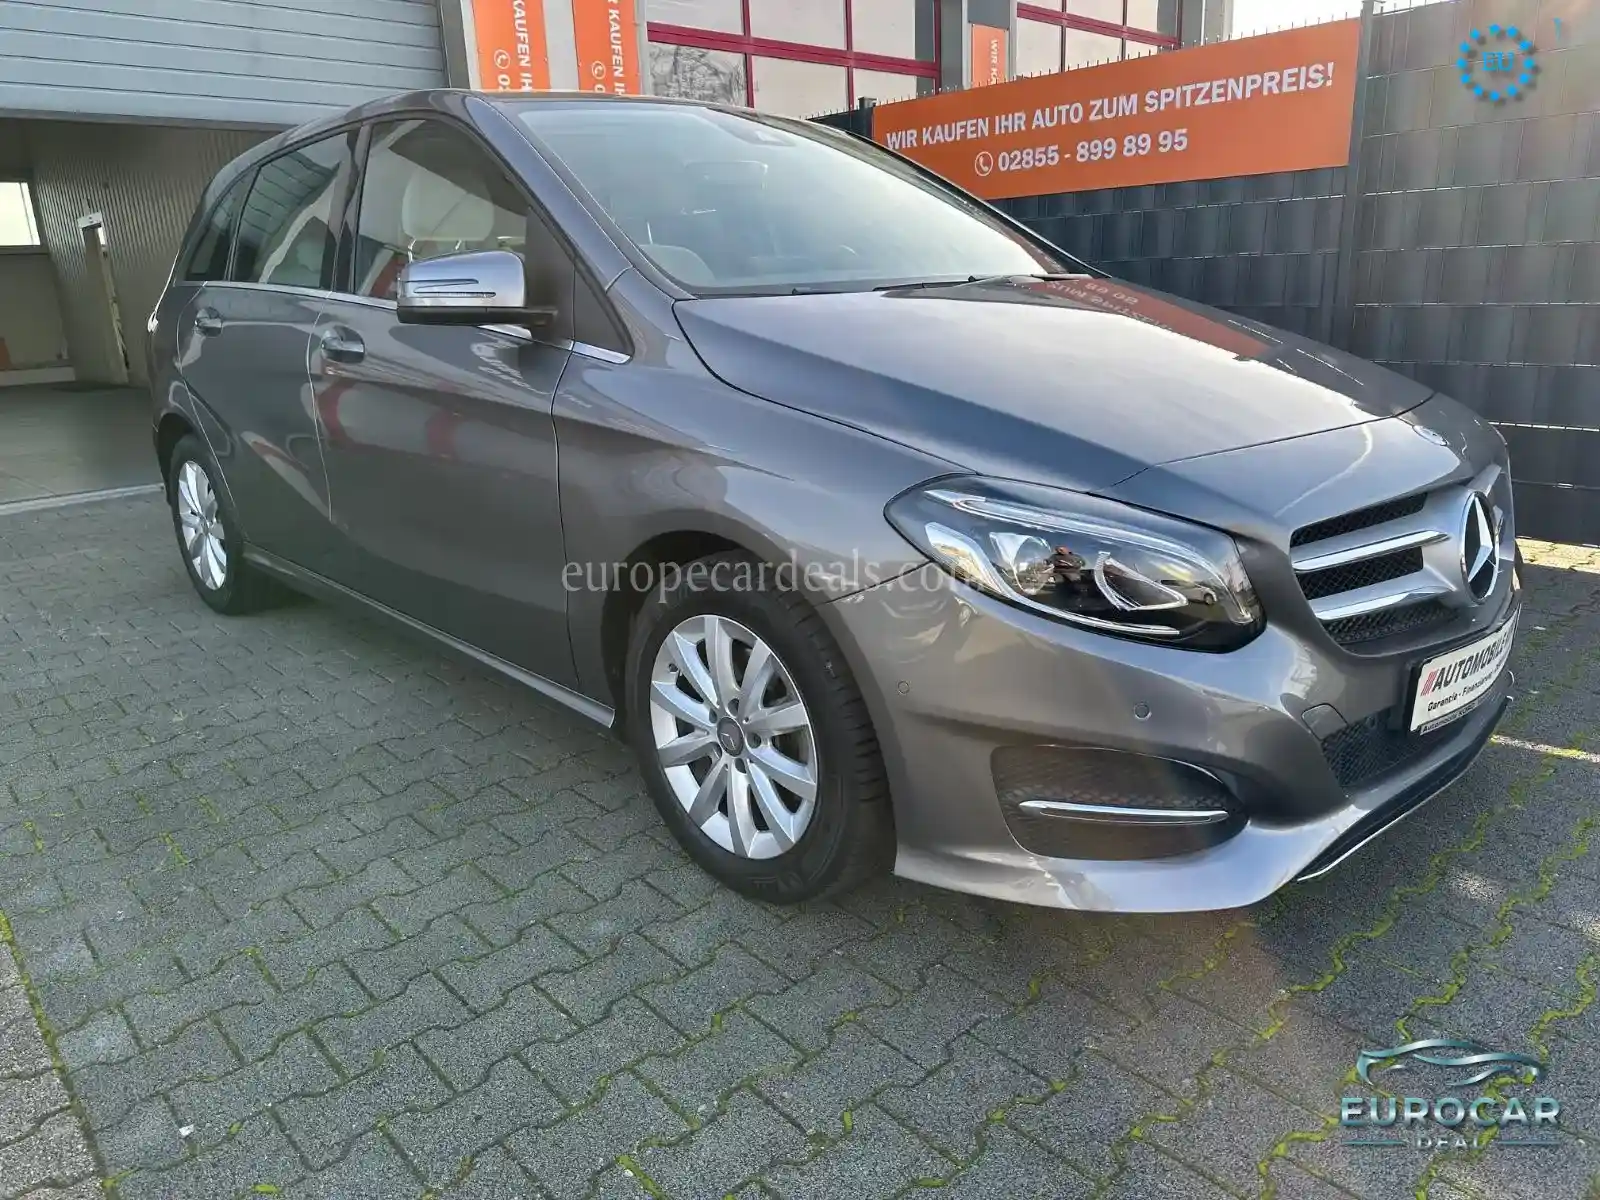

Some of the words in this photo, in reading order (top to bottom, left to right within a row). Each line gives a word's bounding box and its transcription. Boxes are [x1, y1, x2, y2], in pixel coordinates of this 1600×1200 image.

[609, 9, 625, 78] KAUFEN
[886, 129, 918, 150] WIR
[922, 117, 990, 146] KAUFEN
[994, 112, 1027, 135] IHR
[1031, 102, 1084, 130] AUTO
[1089, 94, 1138, 121] ZUM
[1144, 61, 1335, 113] SPITZENPREIS!
[998, 145, 1060, 172] 02855
[1076, 136, 1117, 163] 899
[1123, 133, 1152, 158] 89
[1158, 128, 1189, 152] 95
